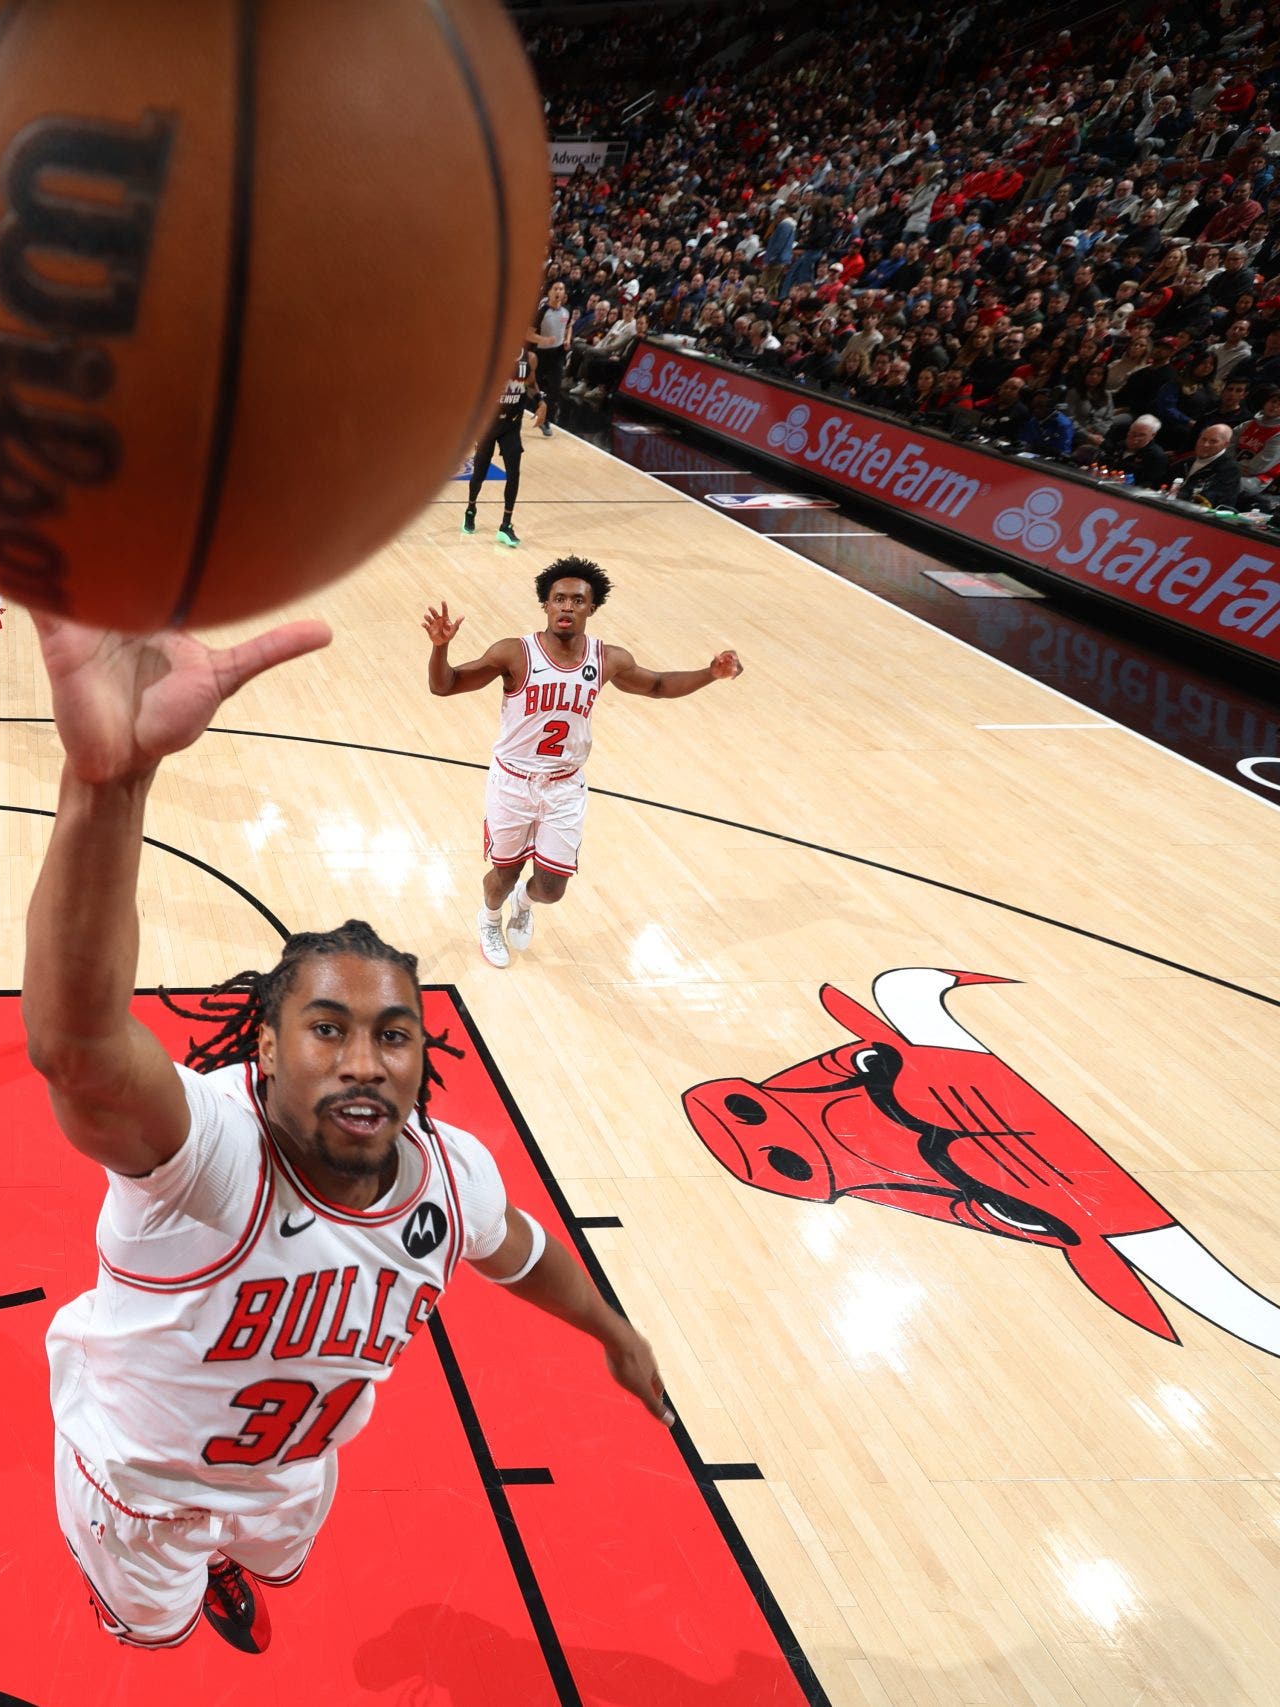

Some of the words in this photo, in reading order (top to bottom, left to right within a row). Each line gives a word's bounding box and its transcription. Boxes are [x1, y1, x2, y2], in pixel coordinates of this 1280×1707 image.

[552, 151, 602, 164] Advocate
[525, 682, 598, 719] BULLS
[536, 720, 570, 757] 2
[202, 1265, 442, 1367] BULLS
[201, 1378, 372, 1466] 31
